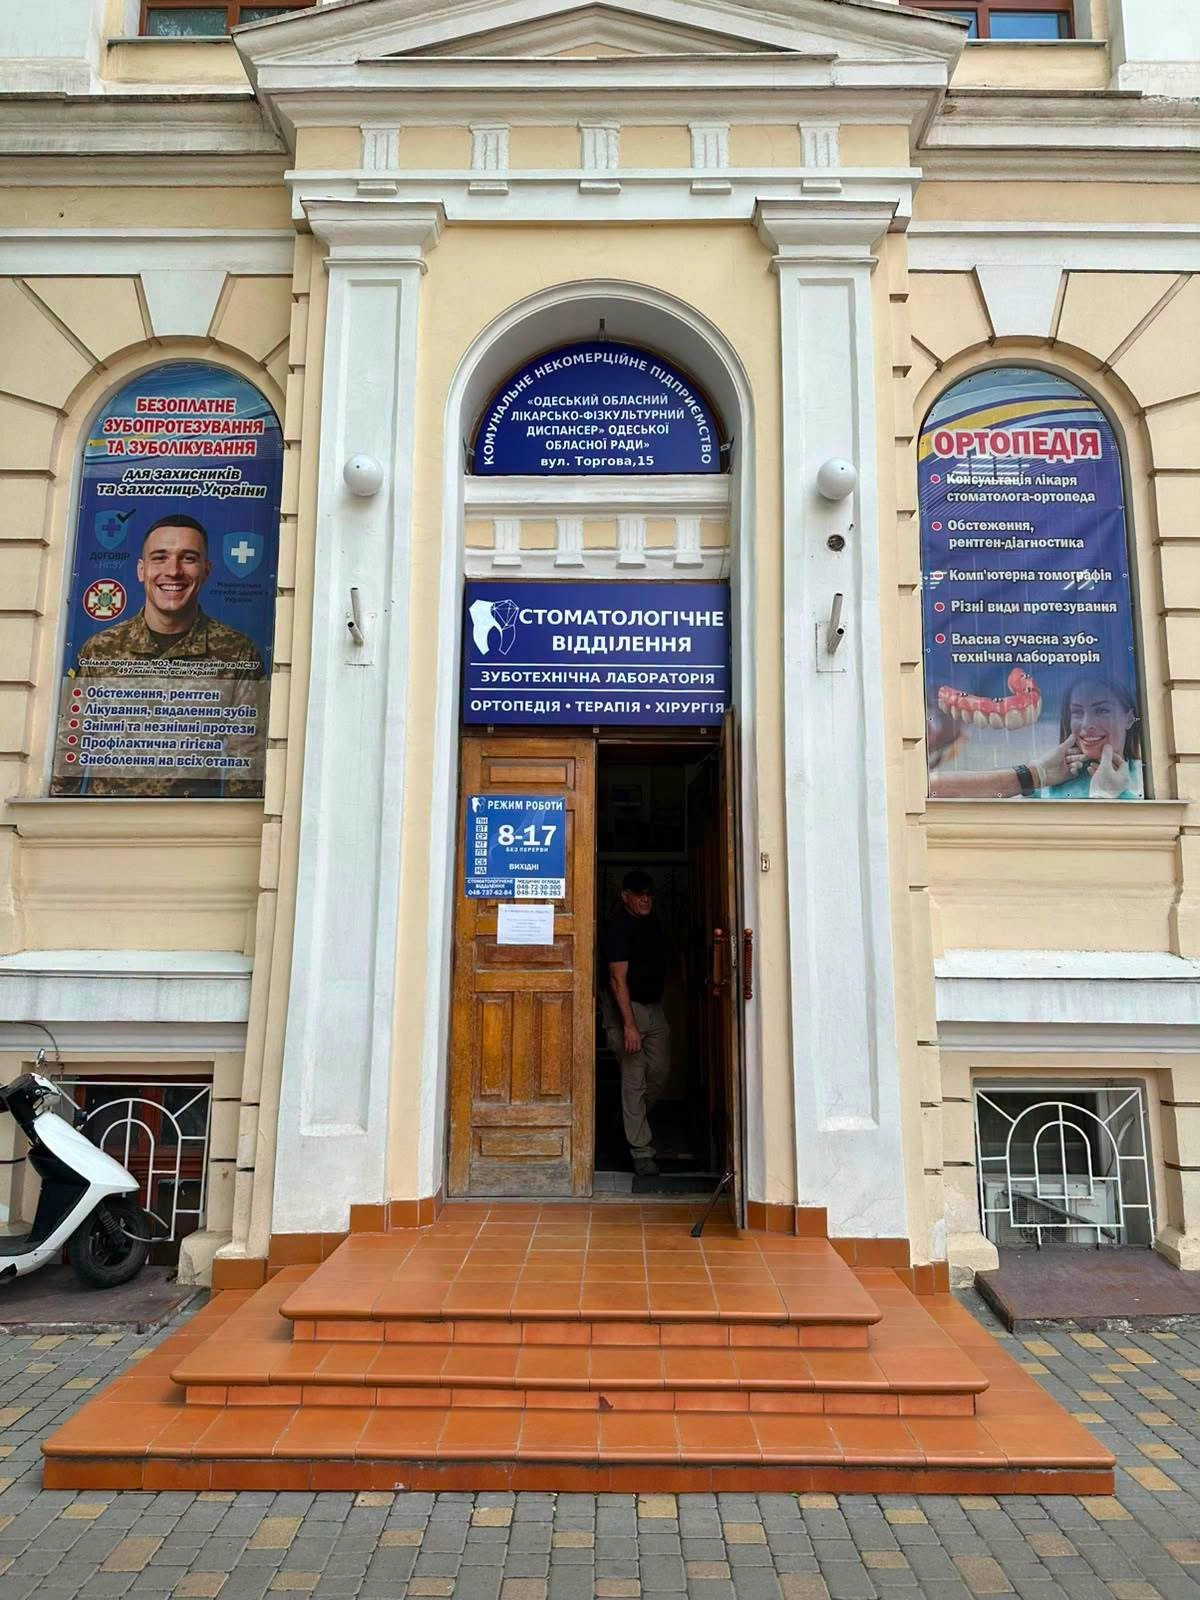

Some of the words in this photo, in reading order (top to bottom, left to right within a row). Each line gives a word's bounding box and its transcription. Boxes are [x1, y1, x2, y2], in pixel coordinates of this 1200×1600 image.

[136, 398, 236, 413] БЕЗОПЛАТНЕ
[527, 394, 599, 408] «ОДЕСЬКИЙ
[602, 392, 668, 405] ОБЛАСНИЙ
[483, 374, 535, 465] КОМУНАЛЬНЕ
[534, 352, 648, 379] НЕКОМЕРЦІЙНЕ
[650, 366, 712, 464] ПІДПРИЄМСТВО
[511, 408, 685, 421] ЛІКАРСЬКО-ФІЗКУЛЬТУРНИЙ
[103, 418, 264, 434] ЗУБОПРОТЕЗУВАННЯ
[526, 425, 605, 437] ДИСПАНСЕР»
[608, 423, 669, 436] ОДЕСЬКОЇ
[107, 440, 125, 454] ТА
[129, 440, 256, 456] ЗУБОЛІКУВАННЯ
[545, 437, 607, 451] ОБЛАСНОЇ
[611, 440, 650, 452] РАДИ»
[934, 430, 1099, 460] ОРТОПЕДІЯ
[540, 457, 571, 469] вул.
[575, 455, 655, 469] Торгова,15
[124, 468, 151, 481] для
[153, 466, 241, 480] захисників
[946, 473, 1032, 487] Консультація
[1035, 474, 1078, 488] лікаря
[98, 484, 116, 495] та
[118, 484, 200, 497] захисниць
[203, 482, 266, 498] України
[946, 492, 1096, 504] стоматолога-ортопеда
[947, 519, 1035, 533] Обстеження,
[949, 536, 1085, 550] рентген-діагностика
[88, 551, 130, 561] ДОГОВІР
[949, 569, 1035, 583] Комп'ютерна
[1037, 569, 1112, 584] томографія
[951, 600, 984, 613] Різні
[987, 603, 1020, 614] види
[1023, 603, 1118, 615] протезування
[519, 608, 724, 627] СТОМАТОЛОГІЧНЕ
[552, 635, 692, 654] ВІДДІЛЕННЯ
[952, 633, 1001, 645] Власна
[1004, 635, 1059, 647] сучасна
[1062, 634, 1098, 647] зубо-
[110, 660, 150, 669] програма
[952, 650, 1013, 663] технічна
[1016, 650, 1101, 664] лабораторія
[480, 671, 601, 683] ЗУБОТЕХНІЧНА
[605, 672, 715, 685] ЛАБОРАТОРІЯ
[87, 687, 168, 702] Обстеження,
[170, 689, 220, 702] рентген
[84, 704, 152, 717] Лікування,
[154, 706, 222, 719] видалення
[223, 705, 257, 719] зубів
[470, 700, 561, 714] ОРТОПЕДІЯ
[575, 701, 641, 713] ТЕРАПІЯ
[655, 702, 725, 714] ХІРУРГІЯ
[82, 720, 126, 732] Знімні
[127, 722, 141, 732] та
[144, 721, 200, 733] незнімні
[203, 724, 255, 736] протези
[82, 736, 178, 751] Профілактична
[179, 737, 222, 750] гігієна
[80, 753, 156, 766] Знеболення
[158, 756, 174, 767] на
[177, 755, 203, 767] всіх
[205, 757, 251, 768] етапах
[487, 800, 523, 810] РЕЖИМ
[526, 800, 563, 811] РОБОТИ
[497, 824, 557, 846] 8-17
[509, 863, 539, 871] ВИХІДНІ
